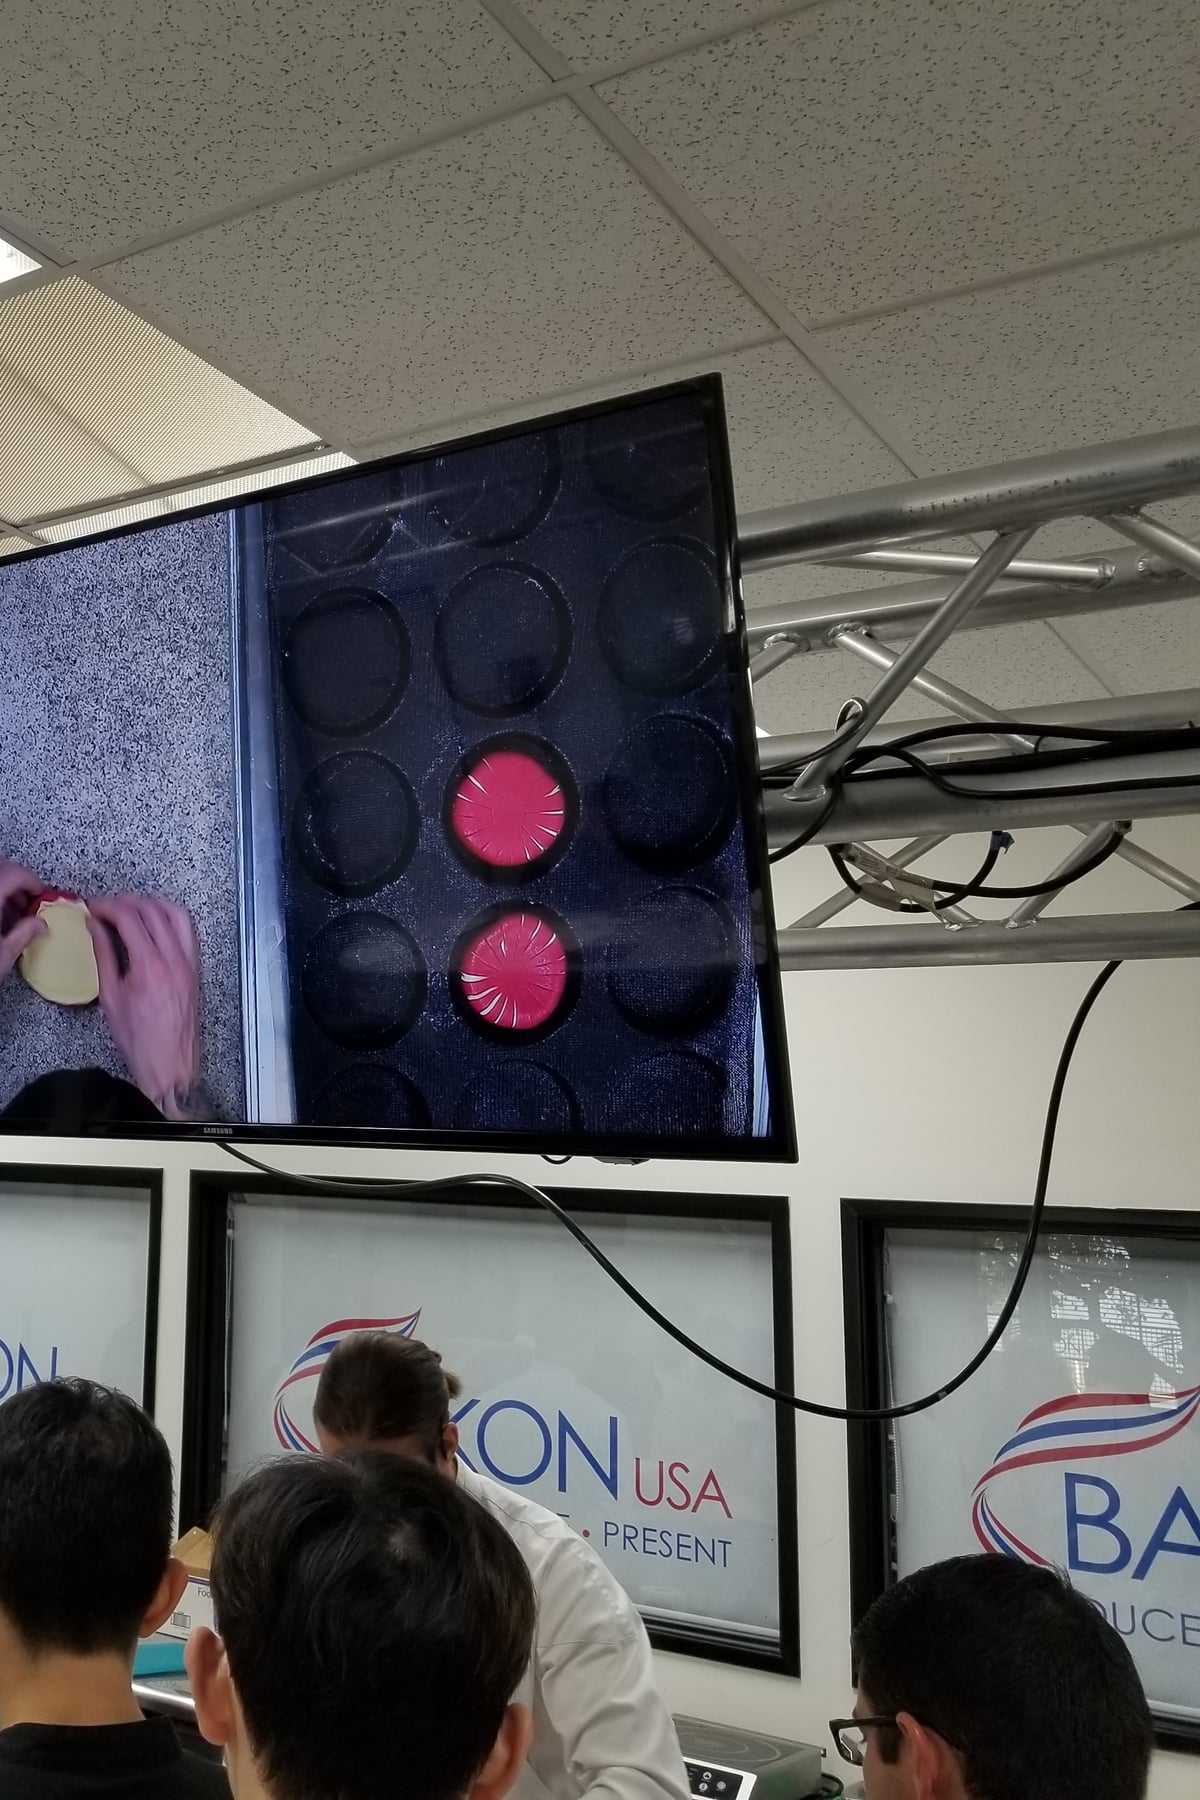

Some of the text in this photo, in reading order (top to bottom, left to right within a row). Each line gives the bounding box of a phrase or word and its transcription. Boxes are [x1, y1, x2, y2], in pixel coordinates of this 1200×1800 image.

[203, 1127, 233, 1135] SAMSUNG
[635, 1457, 733, 1520] USA
[604, 1521, 732, 1568] PRESENT
[1064, 1472, 1200, 1581] BA
[1088, 1598, 1200, 1647] UCE
